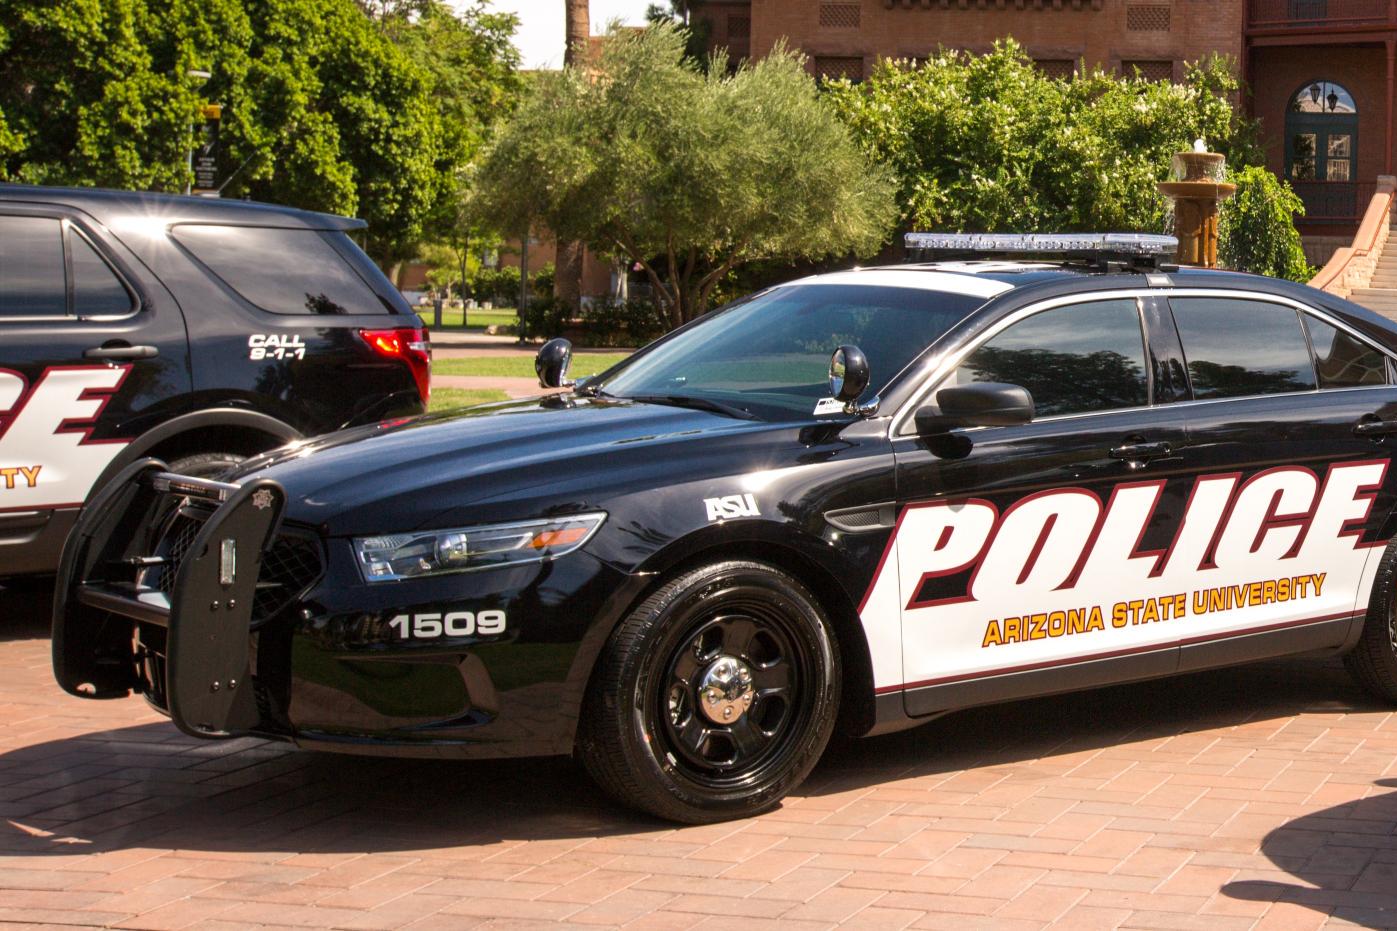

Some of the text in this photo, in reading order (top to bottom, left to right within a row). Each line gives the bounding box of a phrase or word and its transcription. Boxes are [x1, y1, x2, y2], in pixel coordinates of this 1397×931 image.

[248, 334, 306, 348] CALL
[249, 347, 306, 360] 9-1-1
[0, 364, 135, 446] E
[703, 493, 761, 521] ASU
[860, 457, 1392, 612] POLICE
[388, 609, 506, 639] 1509
[982, 572, 1327, 648] ARIZONA STATE UNIVERSITY
